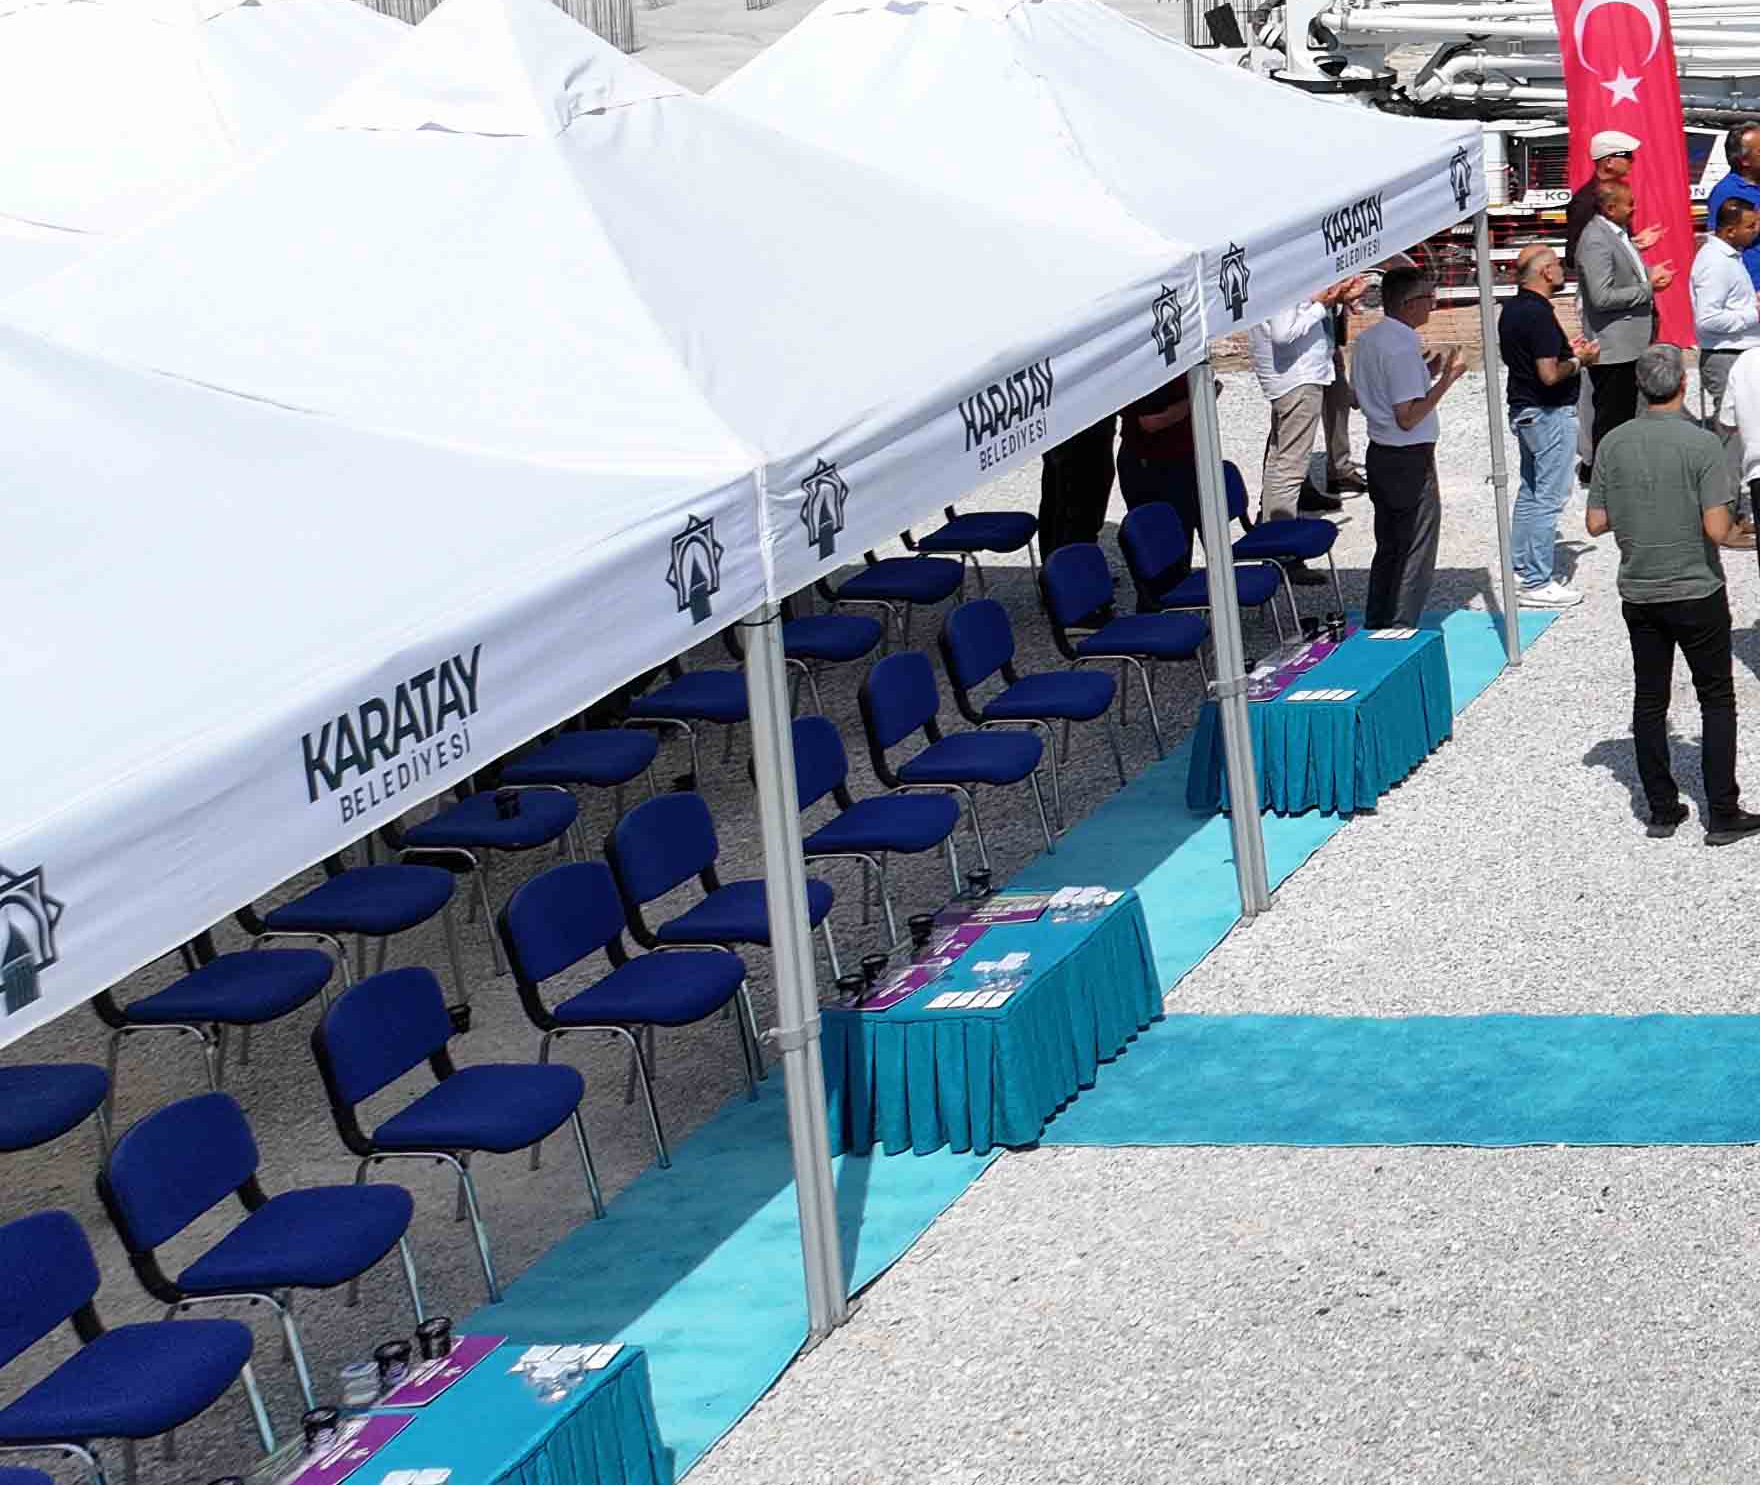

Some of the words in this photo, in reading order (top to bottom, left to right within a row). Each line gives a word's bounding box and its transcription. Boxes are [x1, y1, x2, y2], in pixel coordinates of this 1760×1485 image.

[1320, 191, 1384, 256] KARATAY
[958, 357, 1056, 452] KARATAY
[301, 643, 482, 803] KARATAY
[340, 726, 471, 826] BELEDİYESİ
